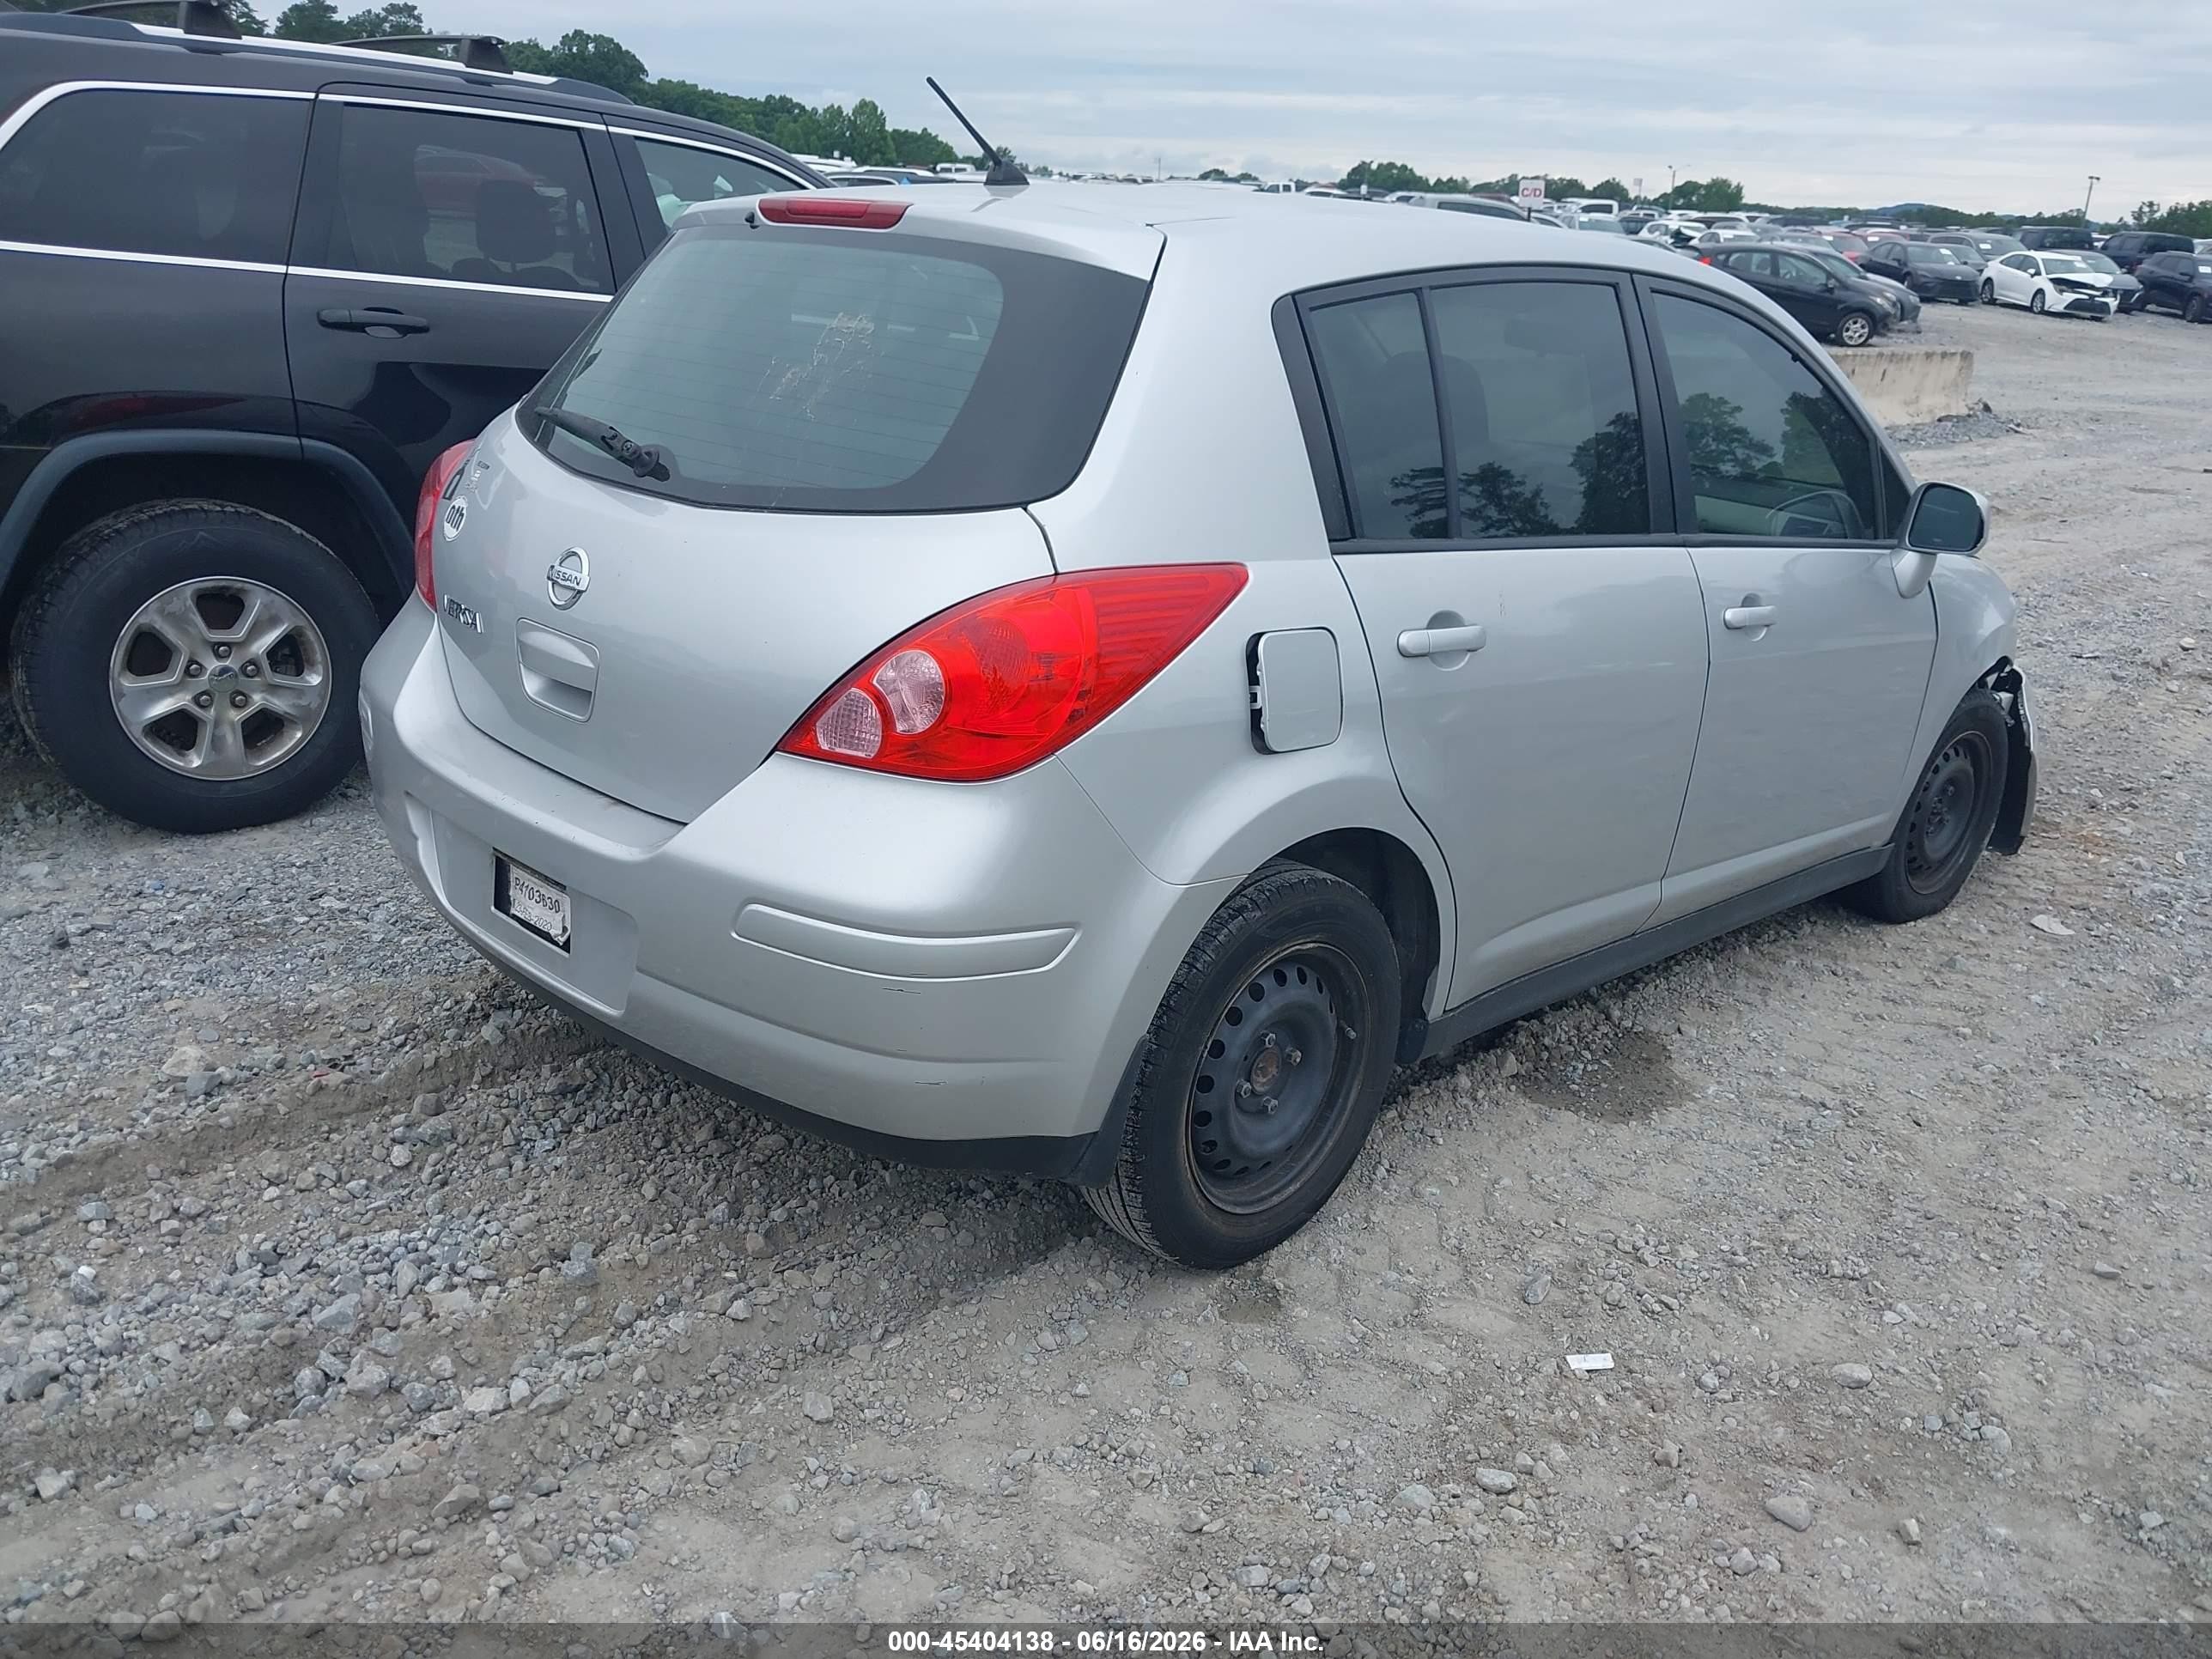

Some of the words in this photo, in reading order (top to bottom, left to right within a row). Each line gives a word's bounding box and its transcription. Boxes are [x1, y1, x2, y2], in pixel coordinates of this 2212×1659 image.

[1521, 187, 1542, 198] C/D
[550, 565, 582, 586] NISSAN
[442, 593, 484, 634] VERSA
